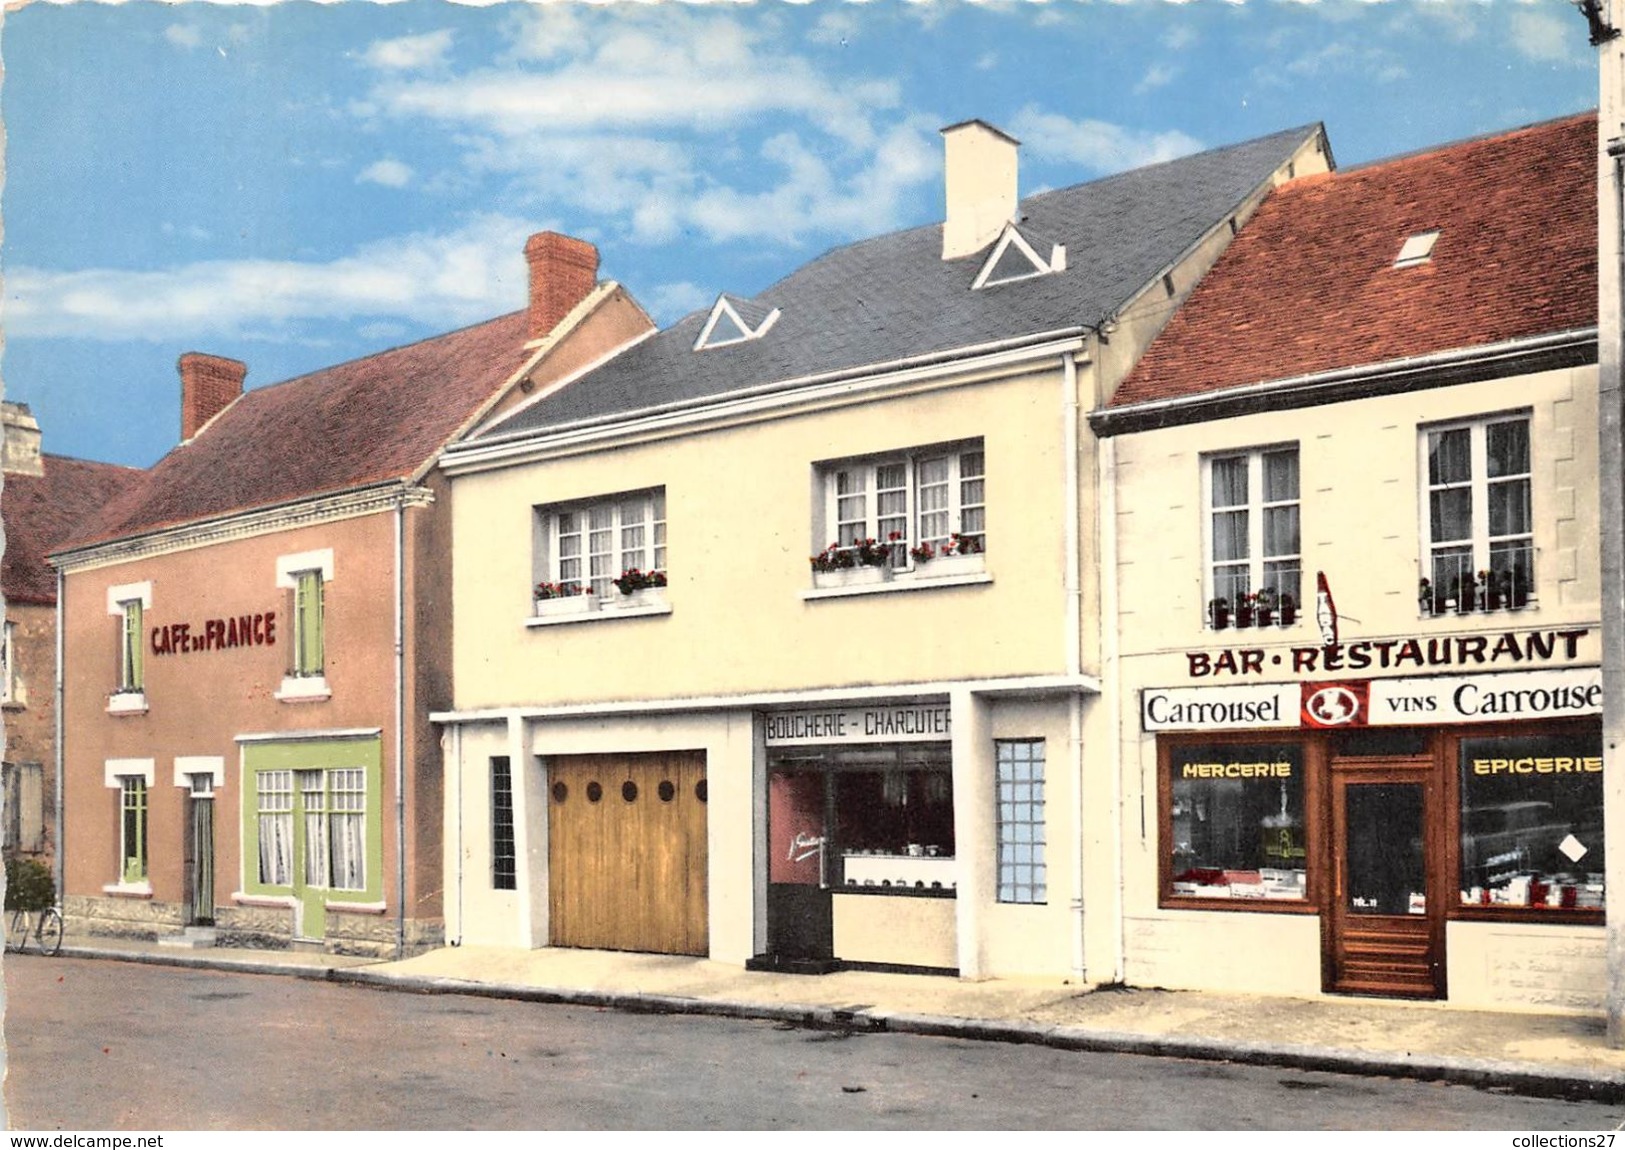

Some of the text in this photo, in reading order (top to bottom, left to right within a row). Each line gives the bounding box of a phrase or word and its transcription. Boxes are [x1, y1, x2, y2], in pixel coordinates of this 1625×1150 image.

[151, 624, 190, 655] CAFE
[206, 612, 276, 650] FRANCE
[1186, 631, 1588, 677] BAR RESTAURANT
[1147, 694, 1280, 725] Carrousel
[1387, 696, 1438, 713] VINS
[767, 714, 847, 739] BOUCHERIE
[1183, 762, 1291, 779] MERCERIE
[1474, 757, 1603, 775] EPICERIE
